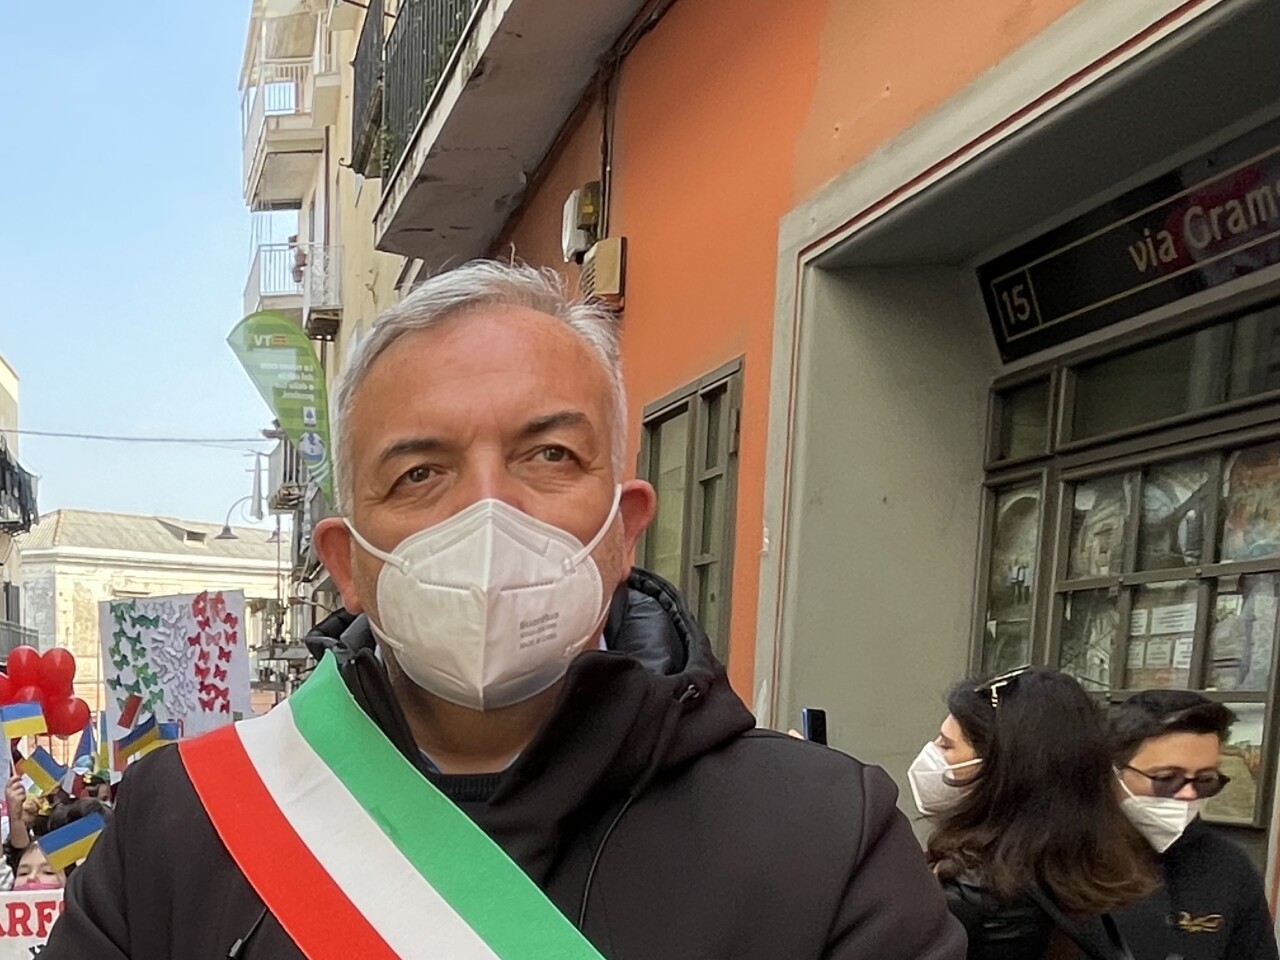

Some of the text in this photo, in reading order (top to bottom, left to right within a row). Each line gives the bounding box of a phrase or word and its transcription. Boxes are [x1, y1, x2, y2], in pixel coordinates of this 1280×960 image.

[1002, 180, 1280, 325] 15 via Gram
